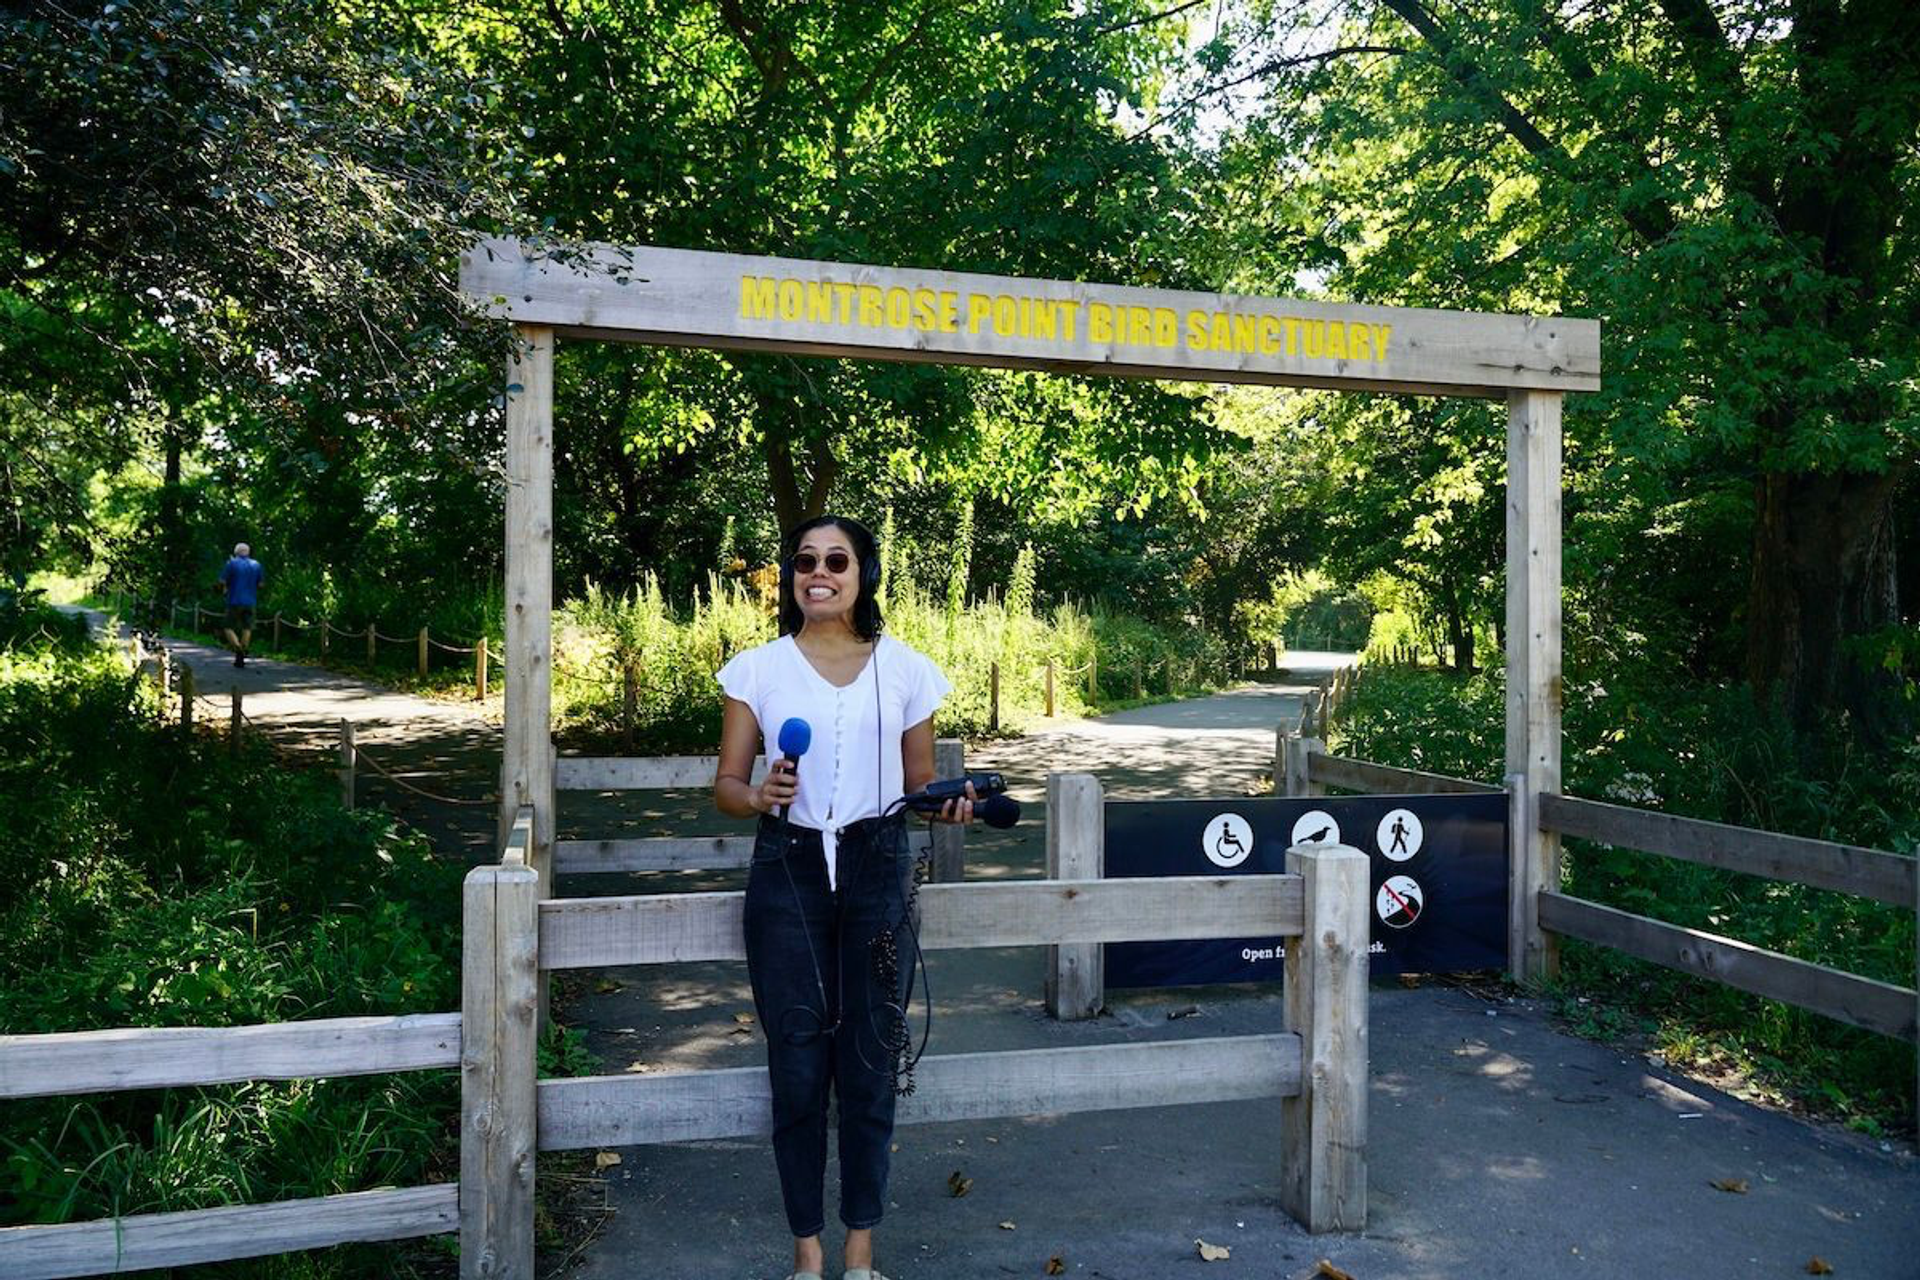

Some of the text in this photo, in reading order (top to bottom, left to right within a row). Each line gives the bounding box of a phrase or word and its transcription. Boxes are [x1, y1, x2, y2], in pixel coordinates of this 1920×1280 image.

[741, 275, 1393, 363] MONTROSE POINT BIRD SANCTUARY
[1241, 947, 1273, 963] Open
